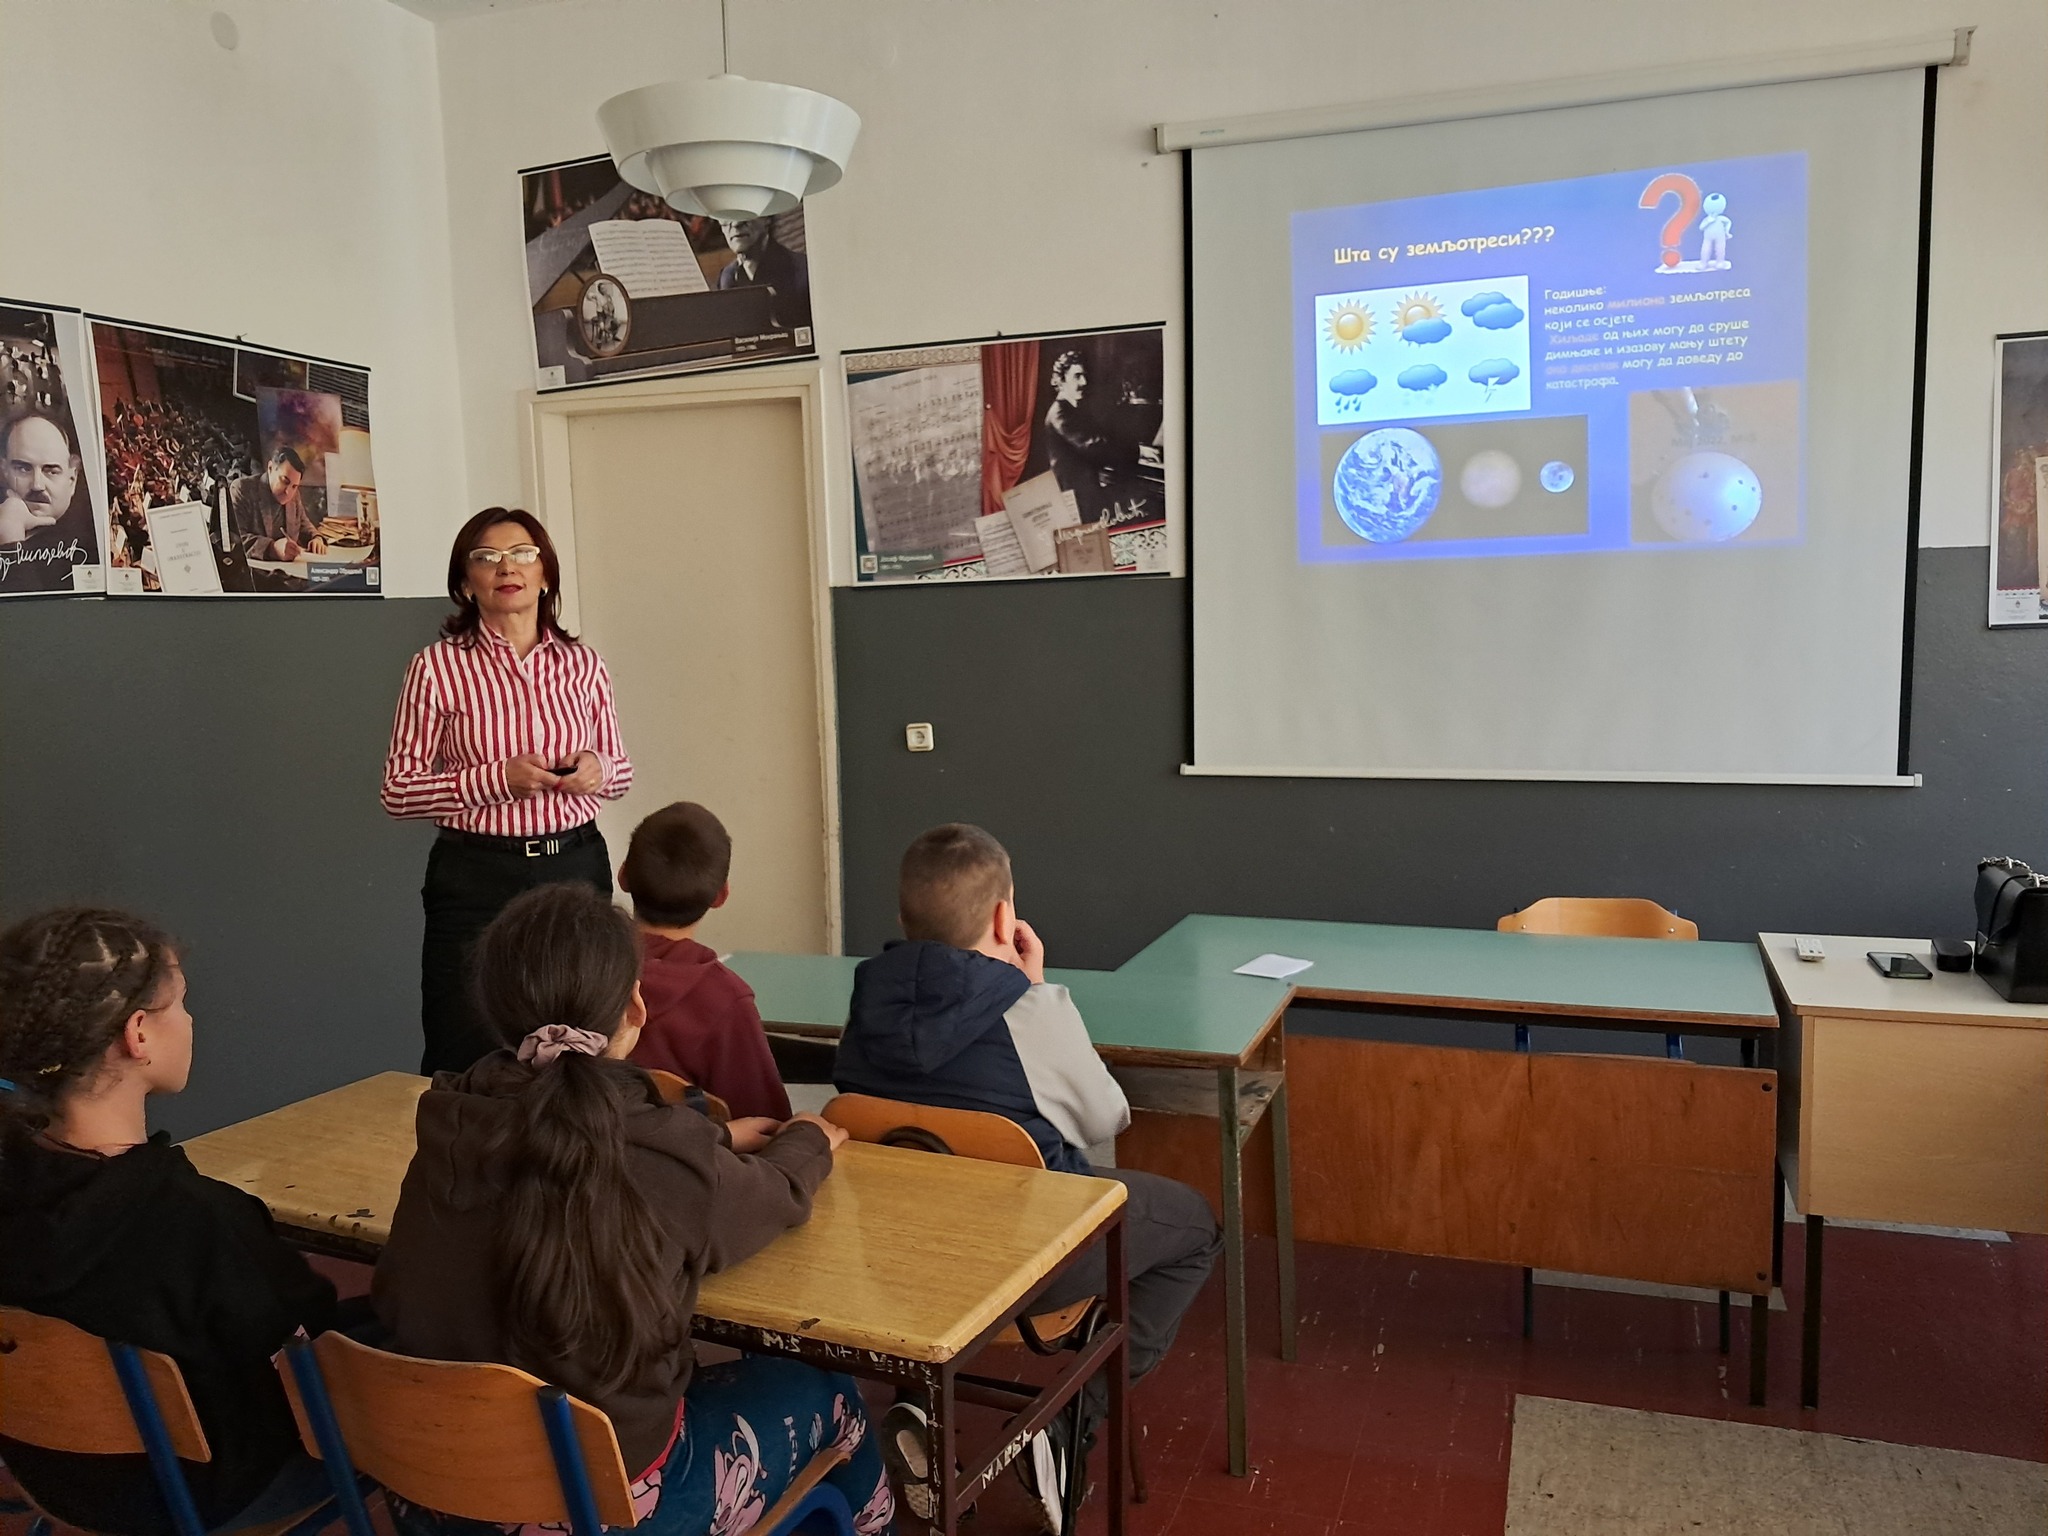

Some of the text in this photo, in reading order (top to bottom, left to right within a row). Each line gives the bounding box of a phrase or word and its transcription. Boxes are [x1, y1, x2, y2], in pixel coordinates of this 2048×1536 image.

[1334, 225, 1555, 264] Шта су земљотреси???
[1544, 286, 1607, 300] Годишње:
[1544, 301, 1604, 315] неколико
[1670, 288, 1751, 304] земљотреса
[1545, 314, 1635, 332] који се осјете
[1603, 331, 1619, 341] од
[1622, 328, 1650, 339] њих
[1653, 325, 1685, 337] могу
[1688, 324, 1704, 334] да
[1708, 320, 1750, 334] сруше
[1545, 336, 1748, 361] димњаке и изазову мању штету
[1622, 359, 1653, 370] могу
[1657, 357, 1673, 367] да
[1676, 353, 1723, 365] доведу
[1726, 351, 1744, 362] до
[1545, 376, 1619, 390] катастрофа.
